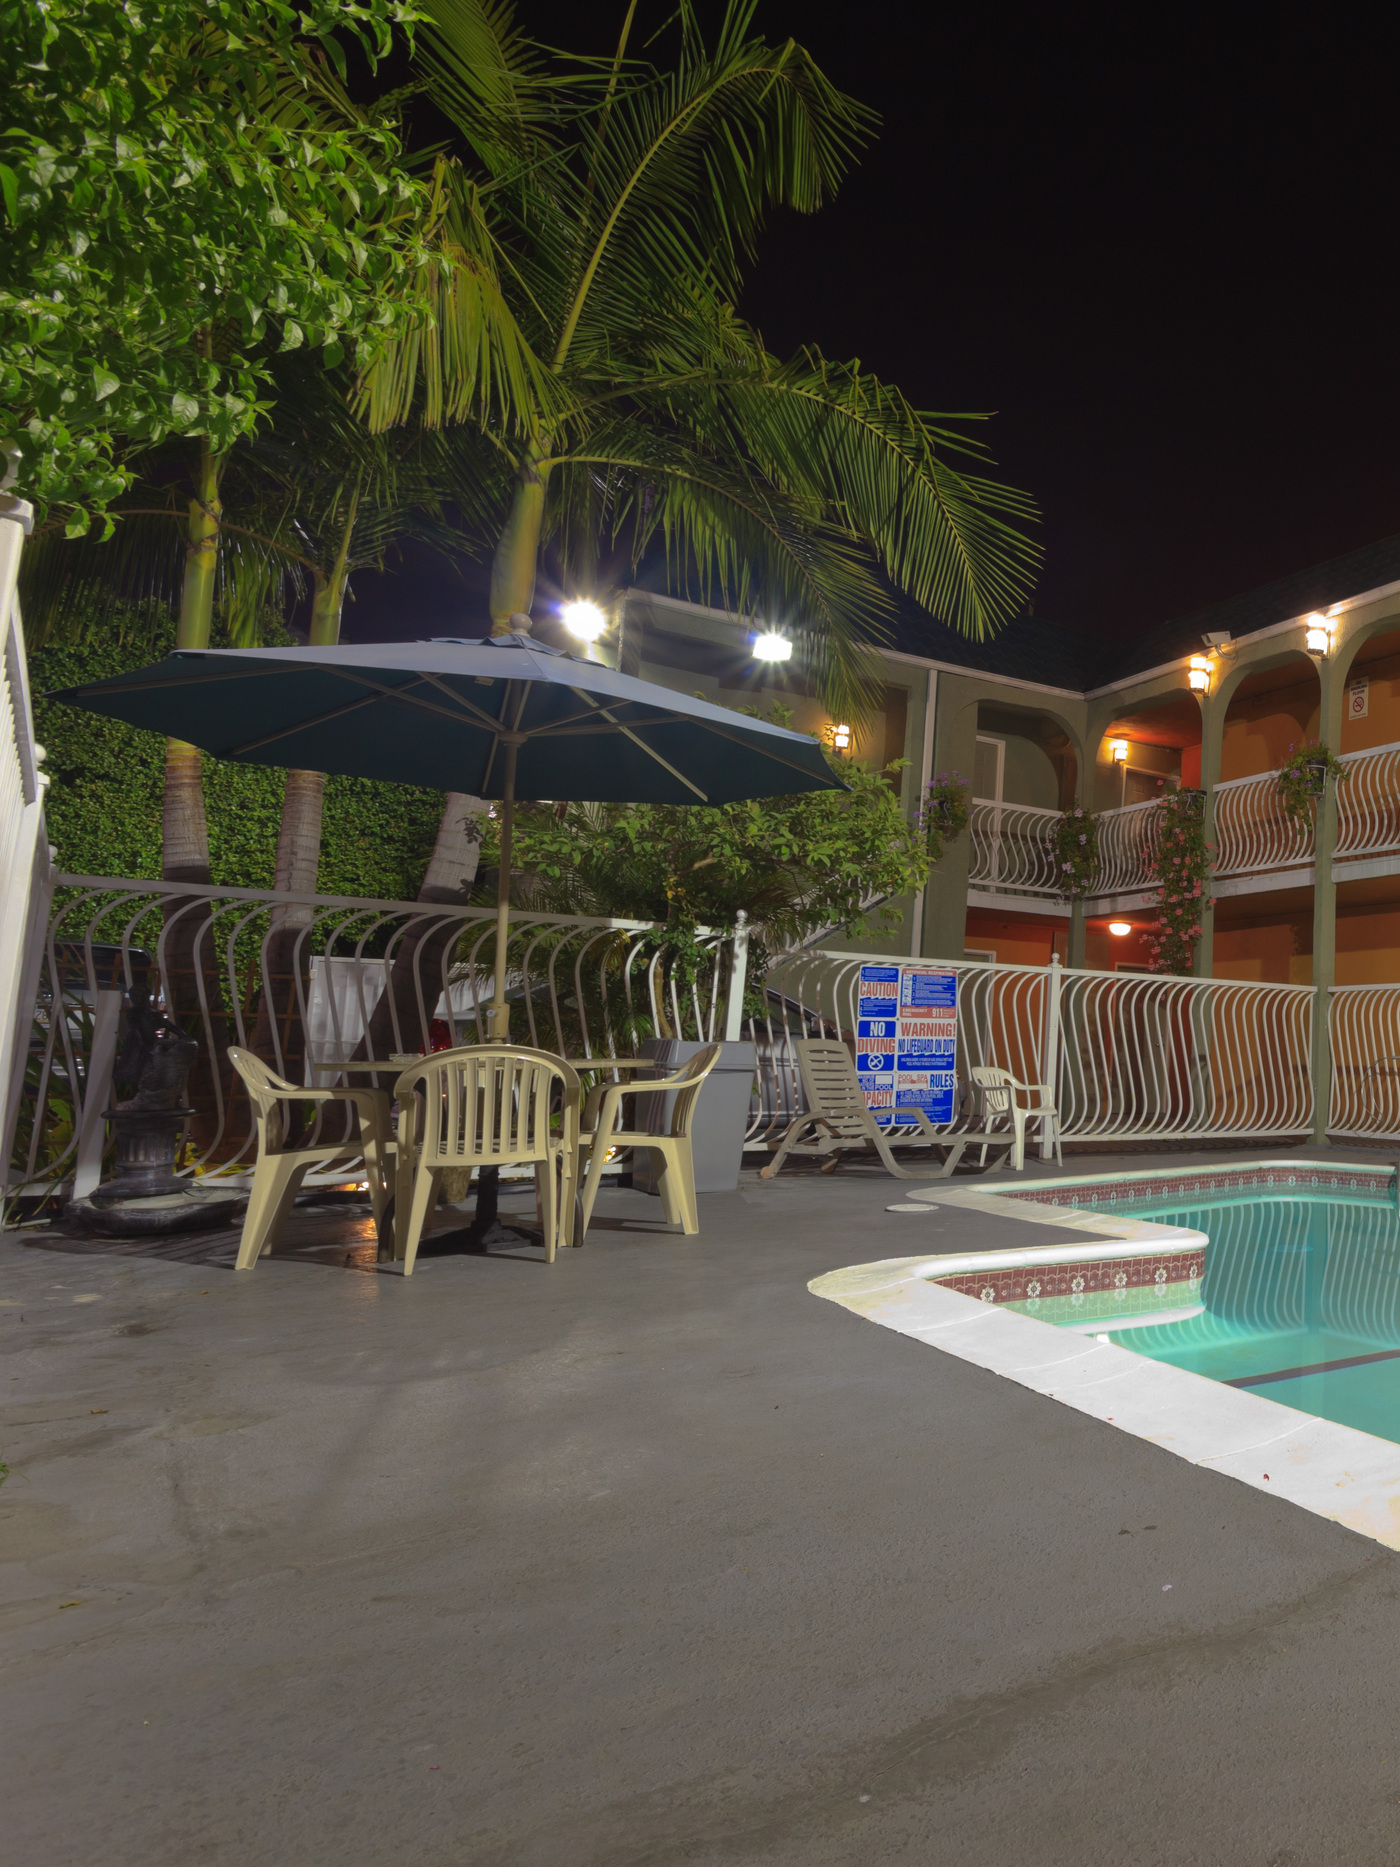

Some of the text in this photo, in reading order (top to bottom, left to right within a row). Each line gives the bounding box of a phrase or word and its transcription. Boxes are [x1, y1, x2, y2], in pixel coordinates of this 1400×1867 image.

[860, 982, 898, 997] CAUTION
[932, 1008, 943, 1017] 911
[869, 1021, 885, 1036] NO
[900, 1022, 956, 1037] WARNING!
[857, 1038, 895, 1053] DIVING
[898, 1038, 956, 1053] NO LIFEGUARD ON DUTY
[898, 1073, 914, 1081] POOL
[916, 1073, 928, 1081] SPA
[929, 1073, 954, 1088] RULES
